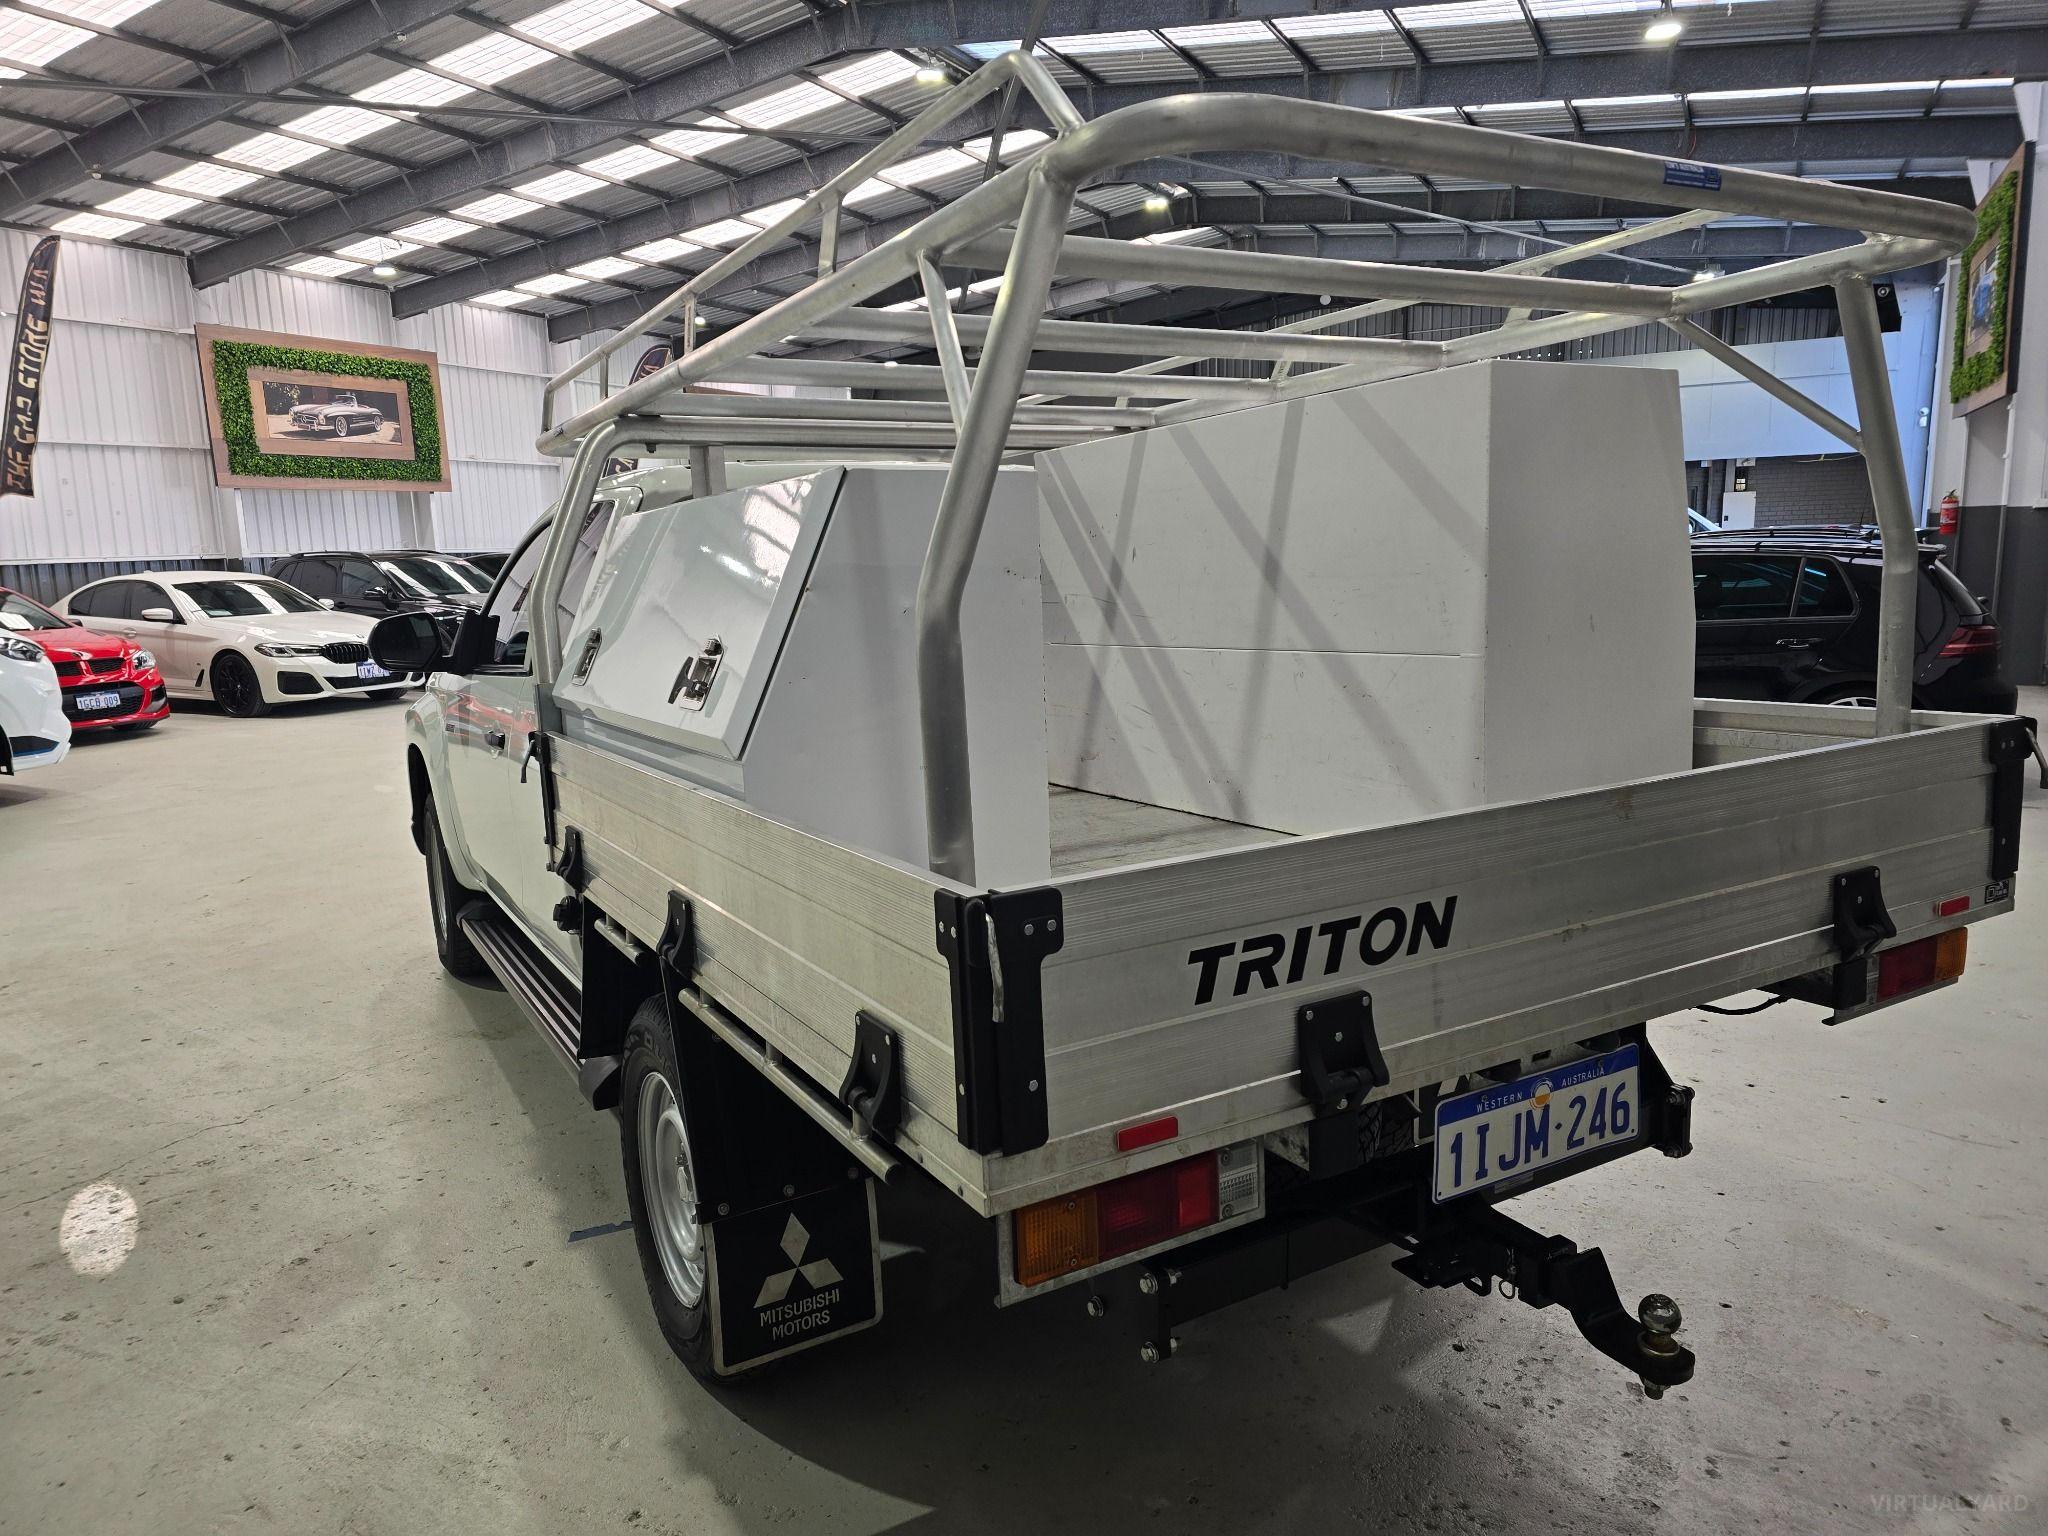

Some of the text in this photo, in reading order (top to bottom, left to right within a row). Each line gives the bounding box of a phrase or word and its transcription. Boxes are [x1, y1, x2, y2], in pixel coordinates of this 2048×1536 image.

[17, 313, 49, 390] STORE
[6, 447, 33, 490] THE
[1187, 895, 1458, 1006] TRITON
[1476, 1066, 1606, 1113] WESTERN AUSTRALIA
[760, 1288, 841, 1327] MITSUBISHI
[772, 1309, 831, 1341] MOTORS
